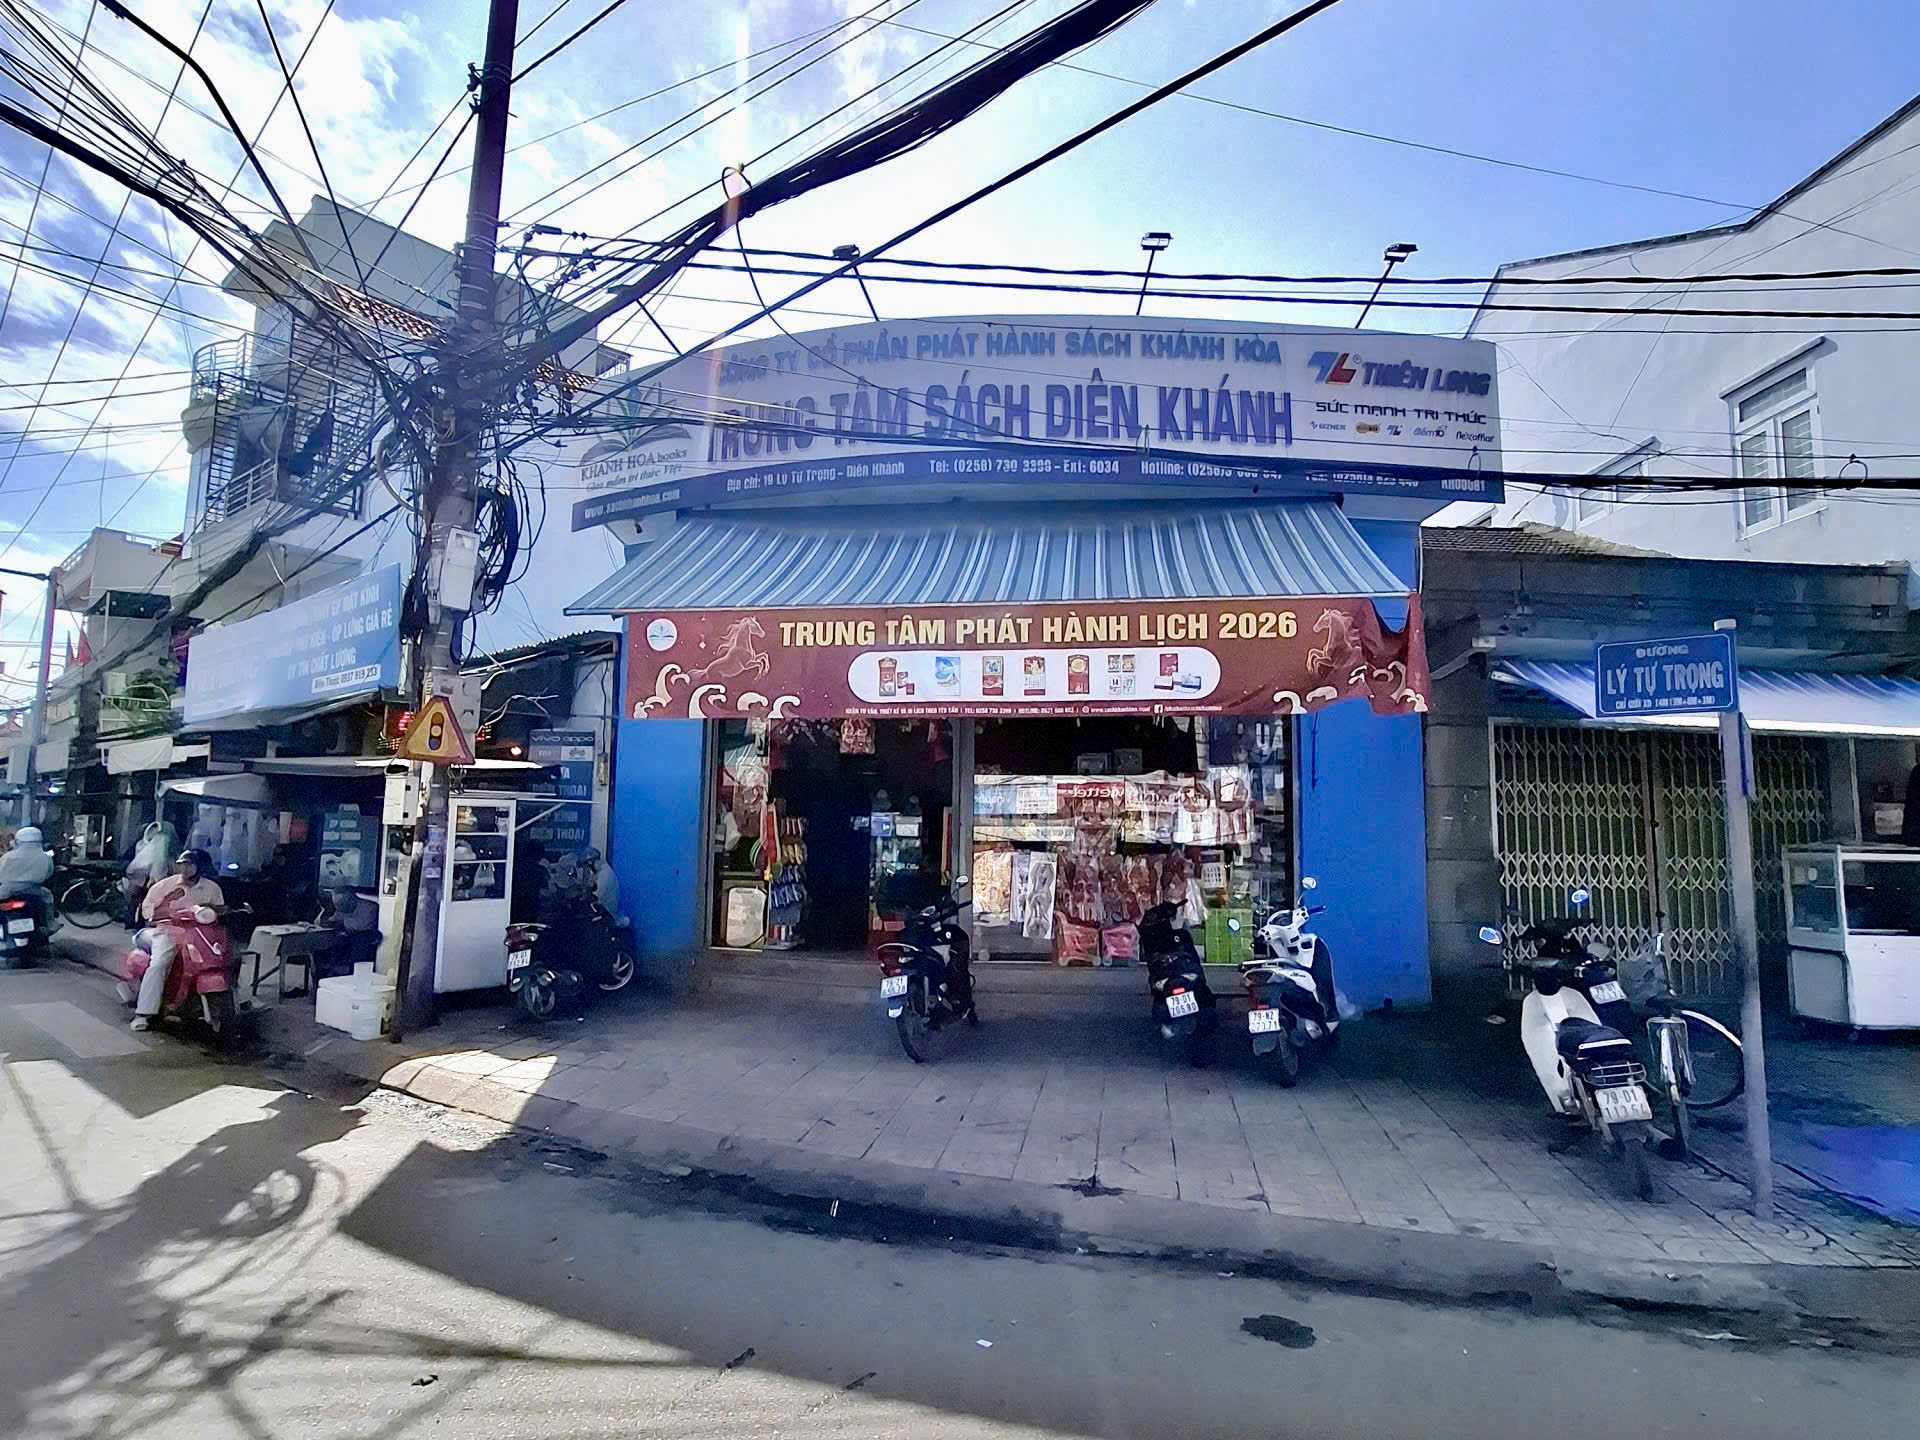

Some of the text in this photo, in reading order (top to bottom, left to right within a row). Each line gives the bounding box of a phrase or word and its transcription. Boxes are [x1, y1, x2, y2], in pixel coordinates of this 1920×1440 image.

[916, 326, 980, 359] PHÁT
[986, 324, 1056, 358] HÀNH
[1064, 325, 1132, 358] SÁCH
[1140, 329, 1225, 362] KHÁNH
[1234, 333, 1283, 366] HÒA
[1362, 359, 1492, 397] THIÊN LONG
[923, 369, 1030, 440] SÁCH
[1045, 368, 1141, 441] DIÊN
[1158, 373, 1294, 447] KHÁNH
[1315, 398, 1350, 415] SỨC
[1443, 409, 1488, 425] THỨC
[763, 473, 774, 487] 19
[929, 459, 950, 473] Tel:
[1089, 460, 1120, 474] 6034
[1140, 460, 1185, 476] Hotline:
[365, 608, 379, 633] GIÁ
[381, 601, 393, 629] RẺ
[778, 611, 1298, 647] TRUNG TÂM PHÁT HÀNH LỊCH 2026
[1606, 660, 1725, 696] LÝ TỰ TRỌNG
[1603, 1089, 1638, 1105] 79-D1
